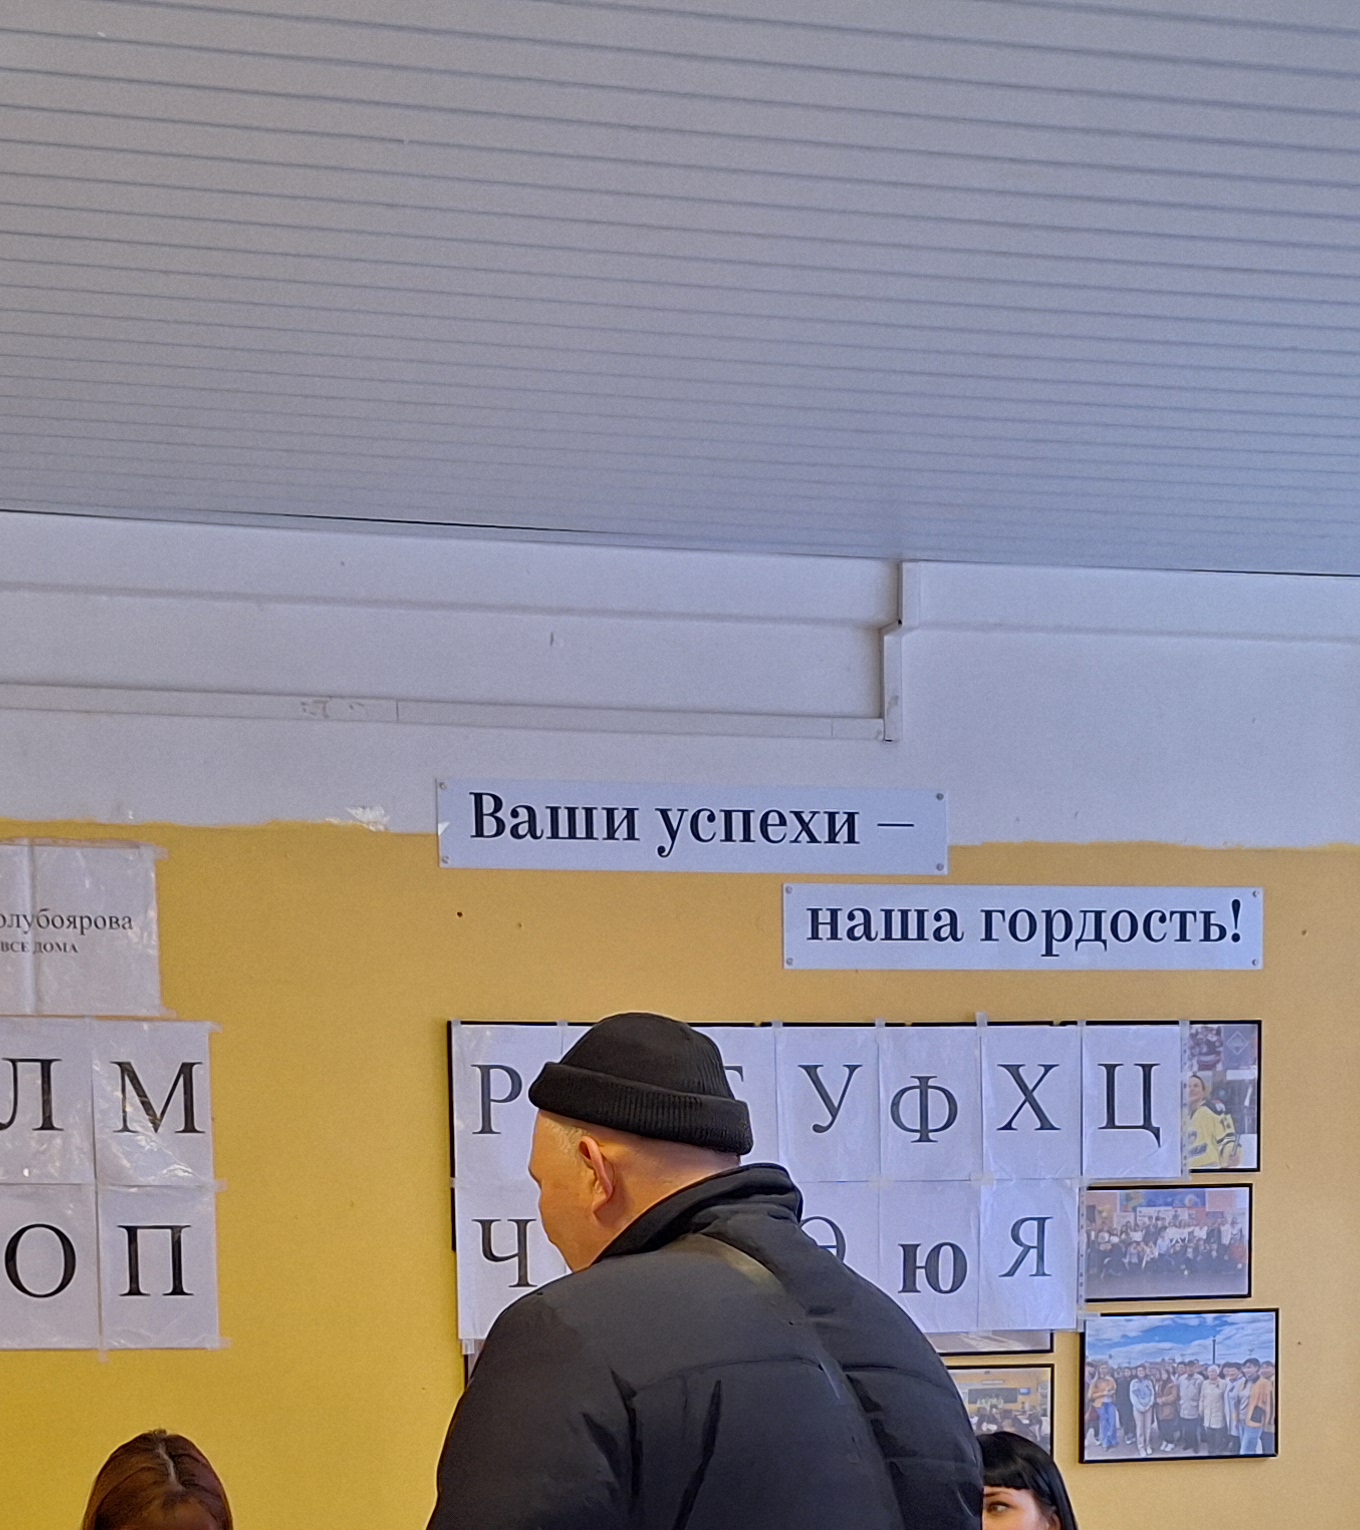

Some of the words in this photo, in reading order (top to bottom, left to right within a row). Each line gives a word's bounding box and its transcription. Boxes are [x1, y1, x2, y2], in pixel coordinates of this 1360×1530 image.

[468, 791, 640, 842] Ваши
[655, 806, 861, 859] успехи
[805, 906, 965, 942] наша
[979, 898, 1243, 958] гордость!
[110, 1061, 206, 1134] М
[471, 1064, 523, 1135] Р
[798, 1063, 863, 1134] У
[889, 1075, 959, 1144] Ф
[996, 1063, 1061, 1132] Х
[1097, 1063, 1161, 1148] Ц
[3, 1222, 77, 1299] О
[116, 1224, 195, 1297] П
[471, 1218, 537, 1288] Ч
[998, 1216, 1054, 1278] Я
